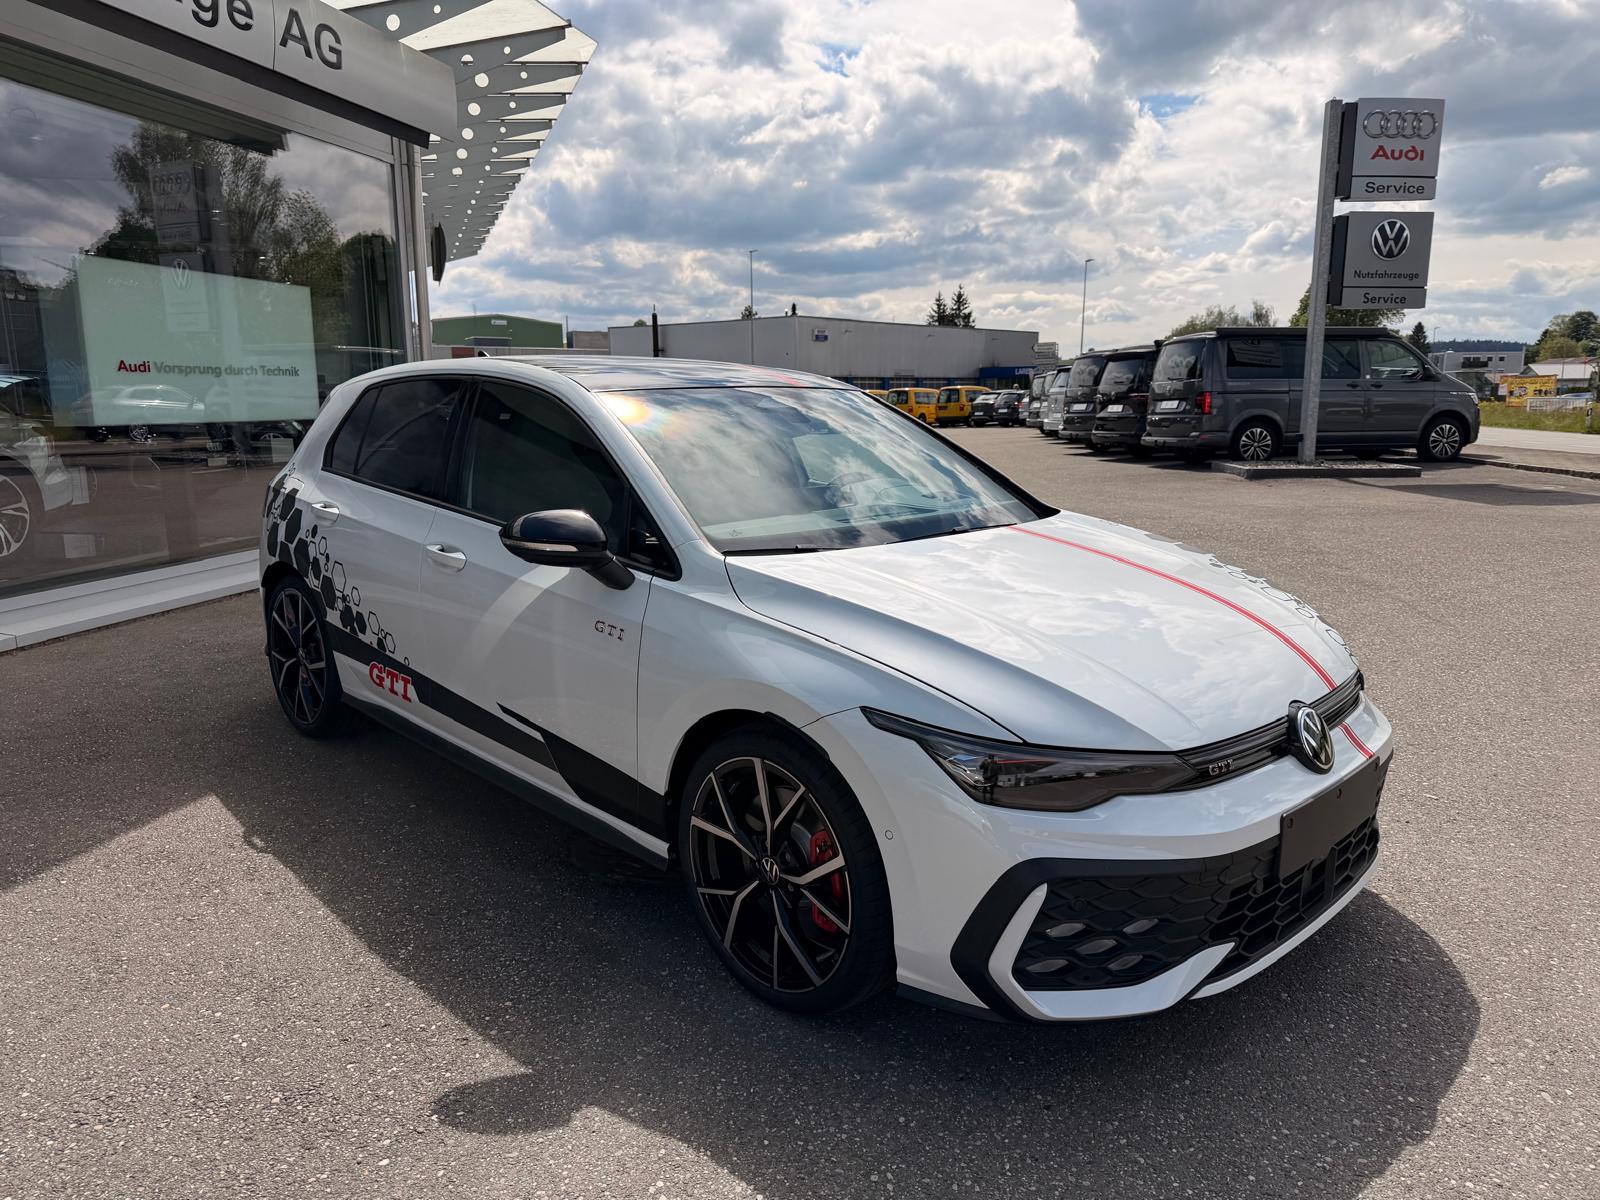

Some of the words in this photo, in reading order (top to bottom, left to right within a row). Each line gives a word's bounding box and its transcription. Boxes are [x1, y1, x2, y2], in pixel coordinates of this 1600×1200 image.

[174, 0, 255, 32] ge
[279, 7, 343, 71] AG
[1369, 145, 1425, 161] Audi
[1364, 181, 1425, 195] Service
[1353, 270, 1420, 281] Nutzfahrzeuge
[1362, 292, 1407, 305] Service
[117, 359, 151, 373] Audi
[152, 361, 222, 378] Vorsprung
[224, 365, 258, 376] durch
[259, 365, 300, 377] Technik
[594, 620, 625, 641] GTI
[369, 661, 412, 703] GTI
[1209, 759, 1235, 776] GTI
